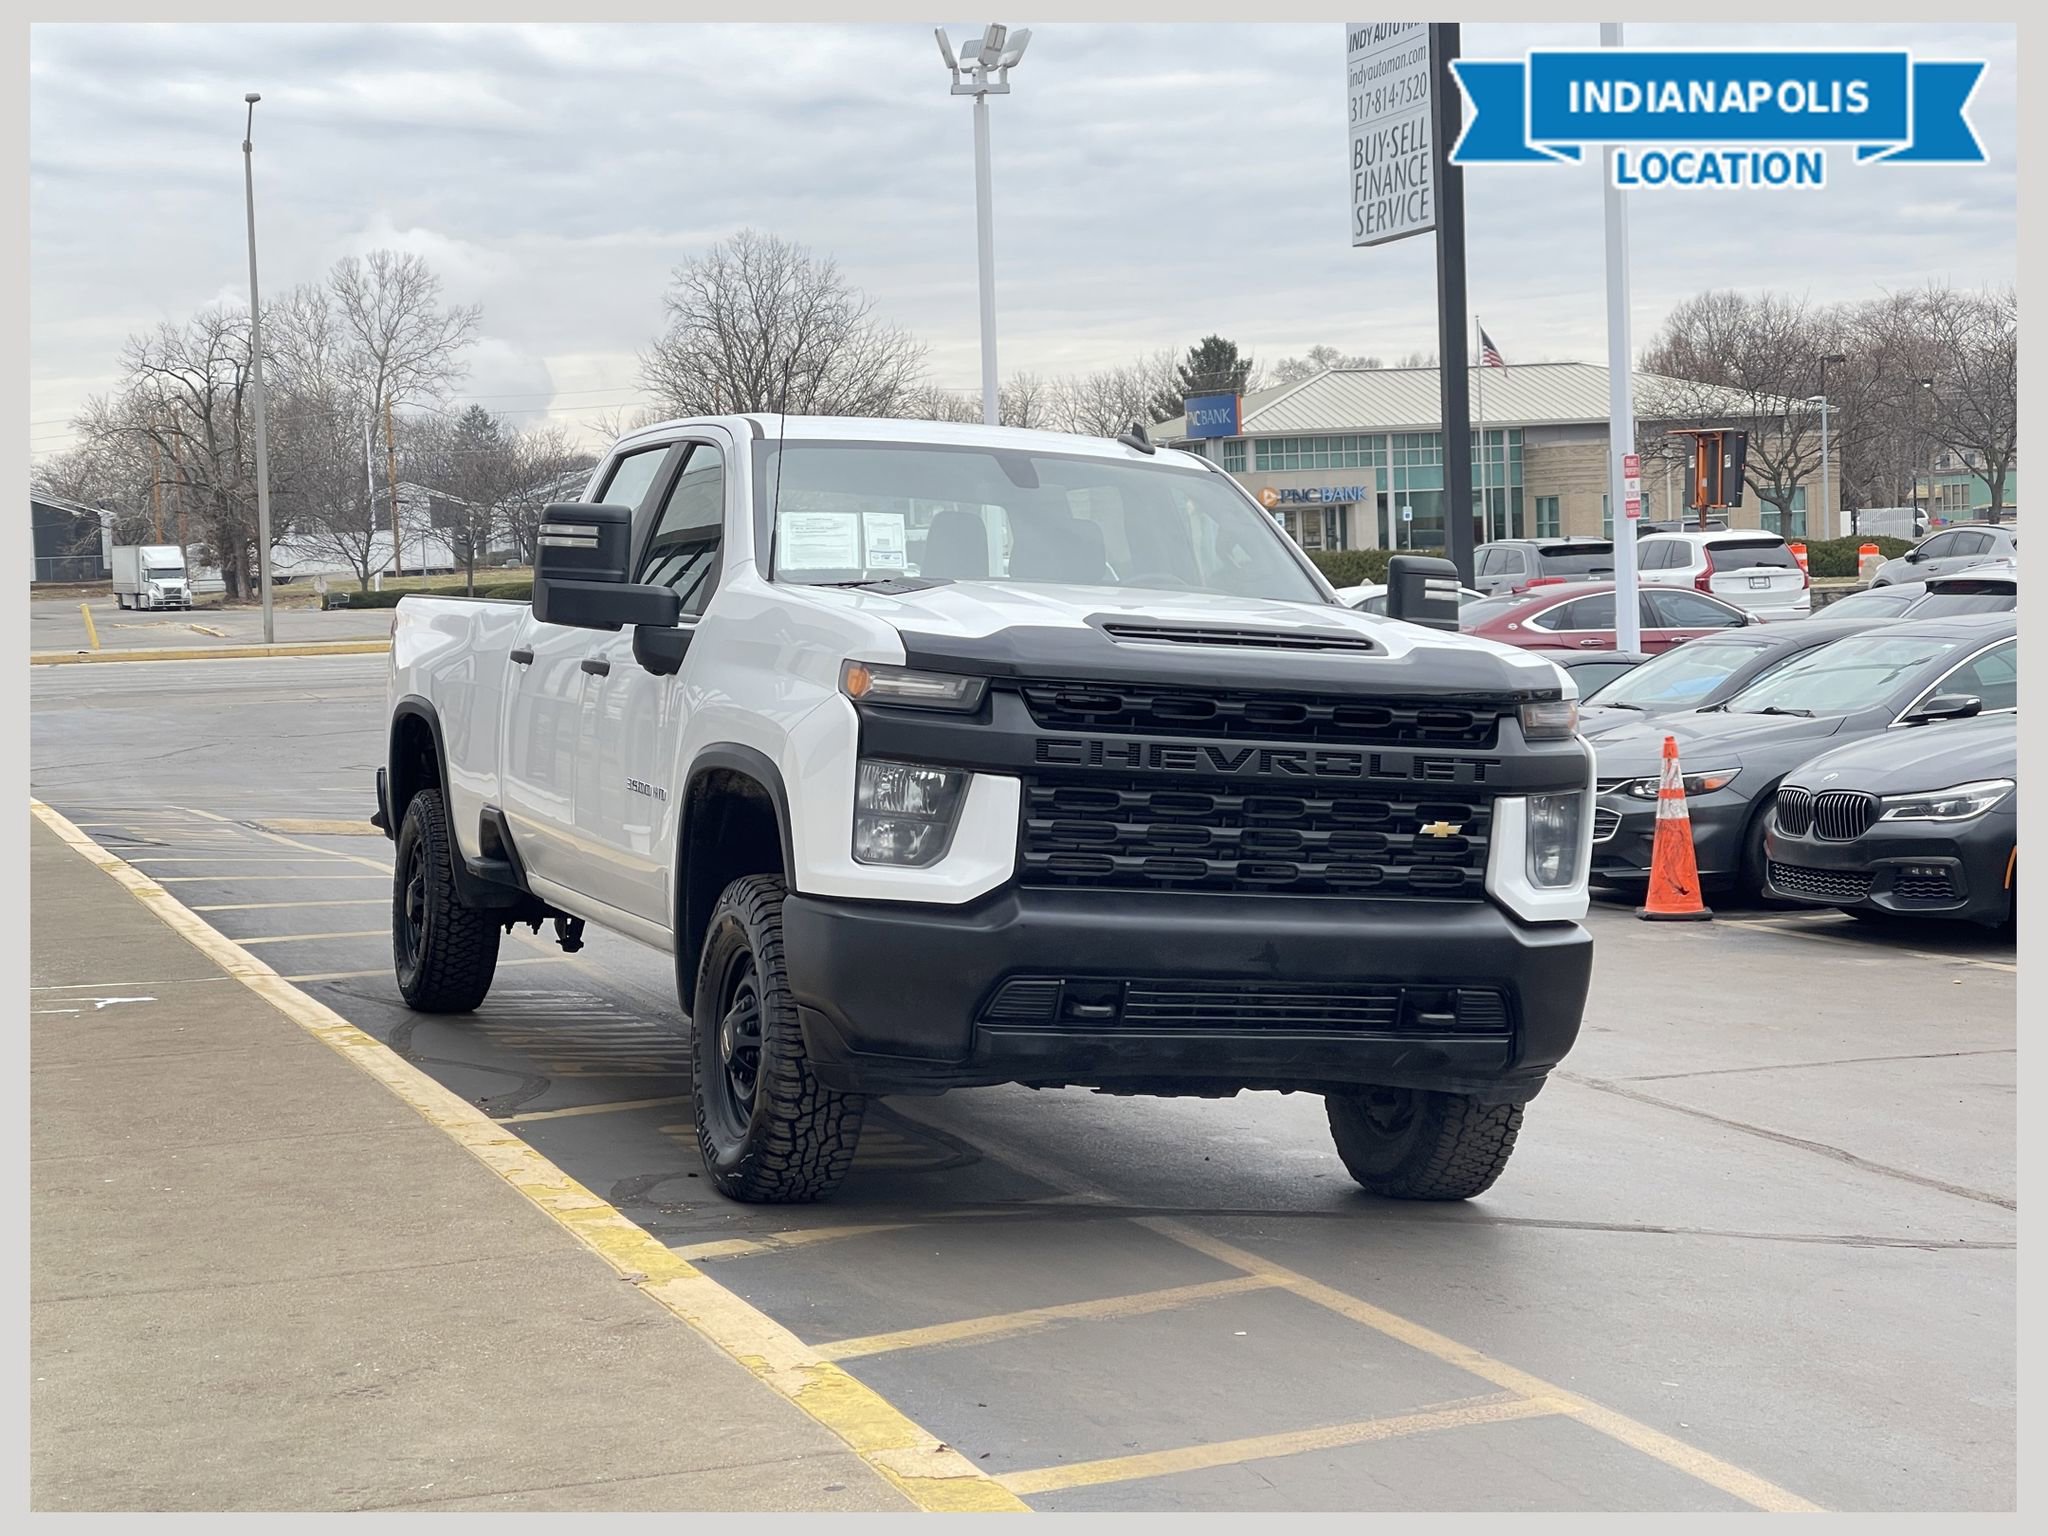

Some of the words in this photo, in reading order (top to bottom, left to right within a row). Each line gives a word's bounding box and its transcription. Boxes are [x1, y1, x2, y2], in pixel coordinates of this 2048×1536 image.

[1348, 26, 1373, 53] INDY
[1349, 44, 1427, 89] indyautoman.com
[1354, 151, 1429, 205] FINANCE
[1355, 187, 1430, 237] SERVICE
[1034, 738, 1501, 783] CHEVROLET
